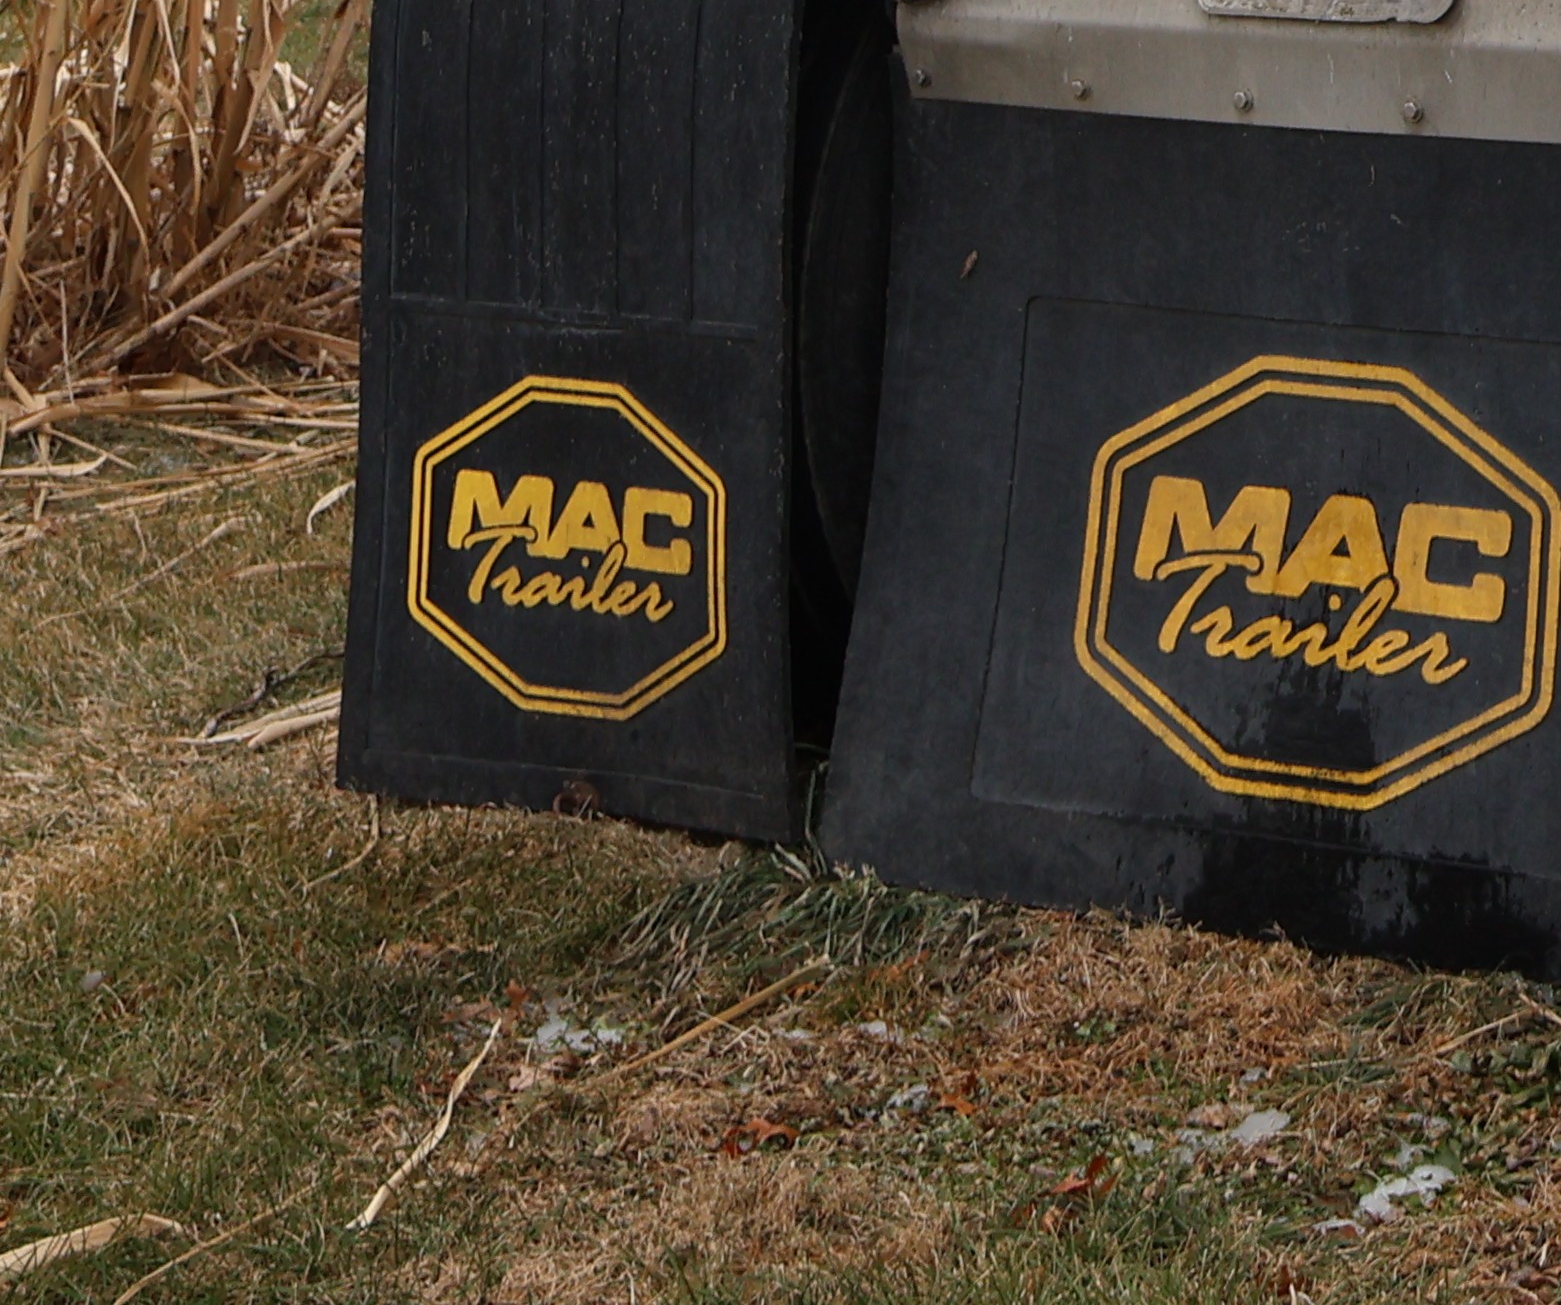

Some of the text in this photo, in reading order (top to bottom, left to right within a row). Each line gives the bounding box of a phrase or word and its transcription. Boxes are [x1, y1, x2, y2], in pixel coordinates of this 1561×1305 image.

[448, 469, 693, 575] MAC
[464, 525, 674, 623] Trailer
[1133, 475, 1513, 623] MAC
[1156, 551, 1468, 685] Trailer
